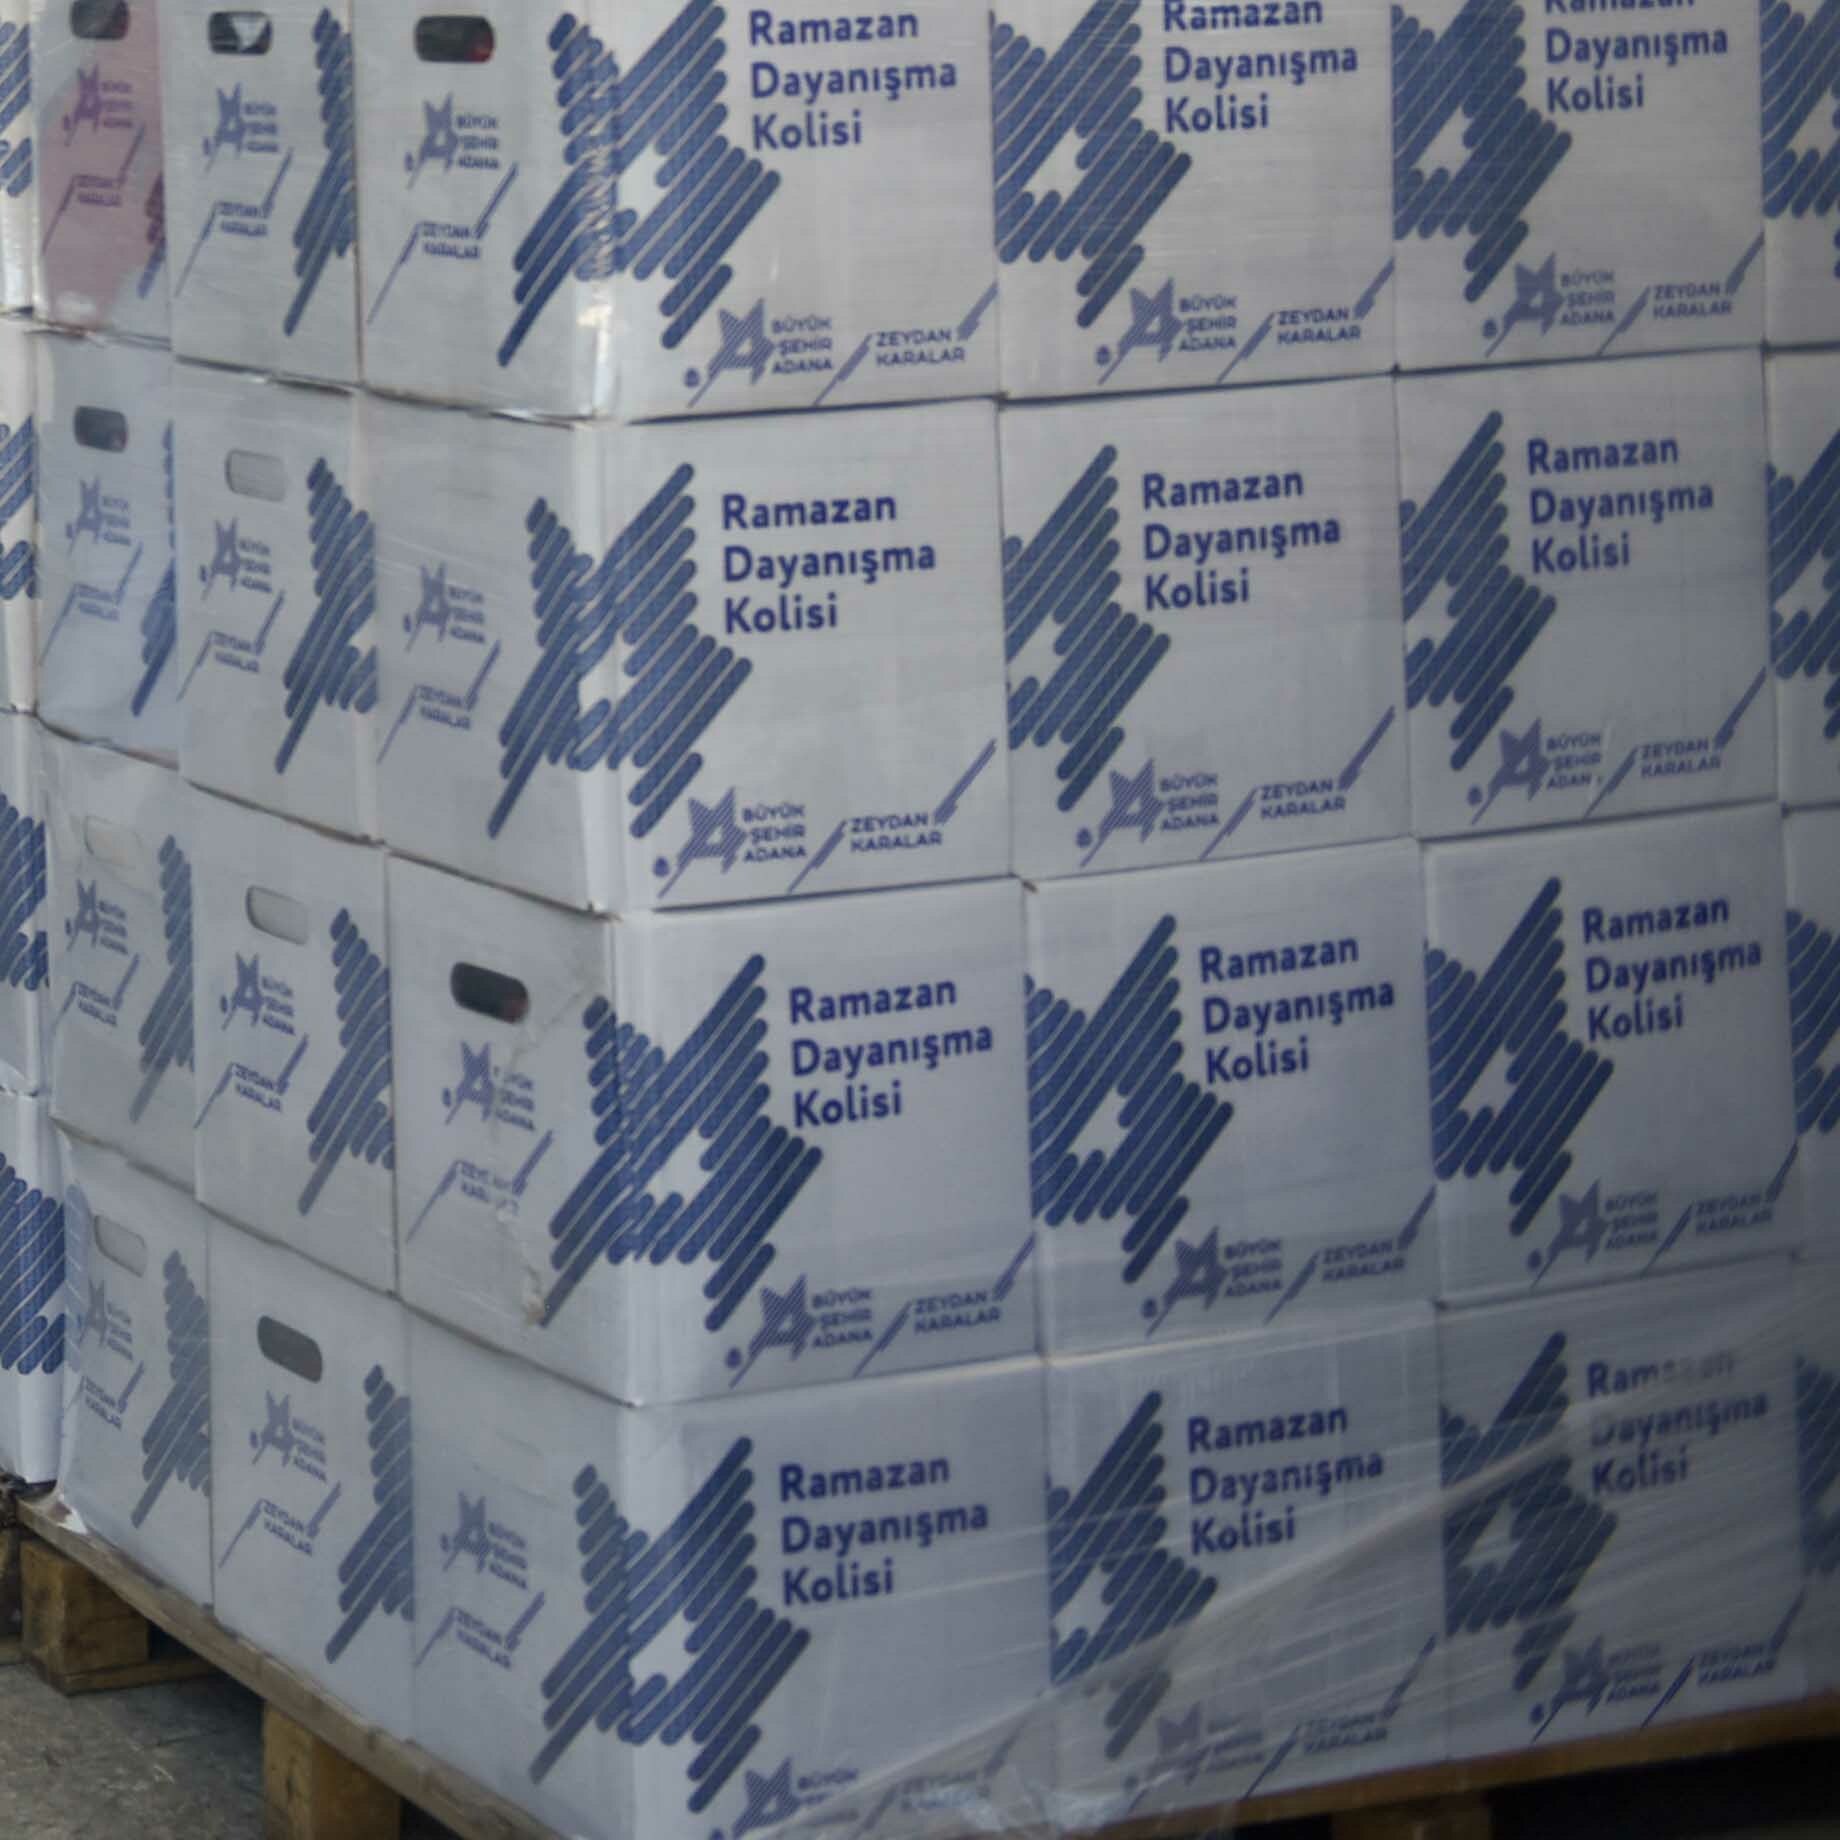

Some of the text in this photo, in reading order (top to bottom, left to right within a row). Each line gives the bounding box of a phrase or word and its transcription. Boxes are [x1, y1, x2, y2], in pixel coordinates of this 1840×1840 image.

[750, 10, 917, 46] Ramazan
[1546, 27, 1727, 69] Dayanışma
[751, 62, 956, 105] Dayanışma
[1165, 47, 1357, 89] Dayanışma
[1166, 93, 1268, 133] Kolisi
[1547, 74, 1643, 113] Kolisi
[752, 110, 861, 151] Kolisi
[1527, 438, 1678, 475] Ramazan
[723, 494, 896, 530] Ramazan
[1143, 472, 1303, 510] Ramazan
[1530, 485, 1713, 530] Dayanışma
[1144, 519, 1340, 565] Dayanışma
[1532, 531, 1629, 574] Kolisi
[724, 545, 935, 589] Dayanışma
[1145, 568, 1248, 611] Kolisi
[726, 592, 836, 634] Kolisi
[1583, 899, 1728, 944] Ramazan
[1200, 939, 1358, 983] Ramazan
[1585, 943, 1761, 996] Dayanışma
[790, 982, 955, 1024] Ramazan
[1203, 983, 1394, 1037] Dayanışma
[1588, 994, 1683, 1042] Kolisi
[792, 1027, 992, 1080] Dayanışma
[1206, 1036, 1308, 1085] Kolisi
[794, 1080, 901, 1128] Kolisi
[1188, 1406, 1348, 1454] Ramazan
[780, 1459, 949, 1502] Ramazan
[1188, 1452, 1384, 1508] Dayanışma
[1592, 1444, 1690, 1496] Kolisi
[782, 1505, 988, 1558] Dayanışma
[1191, 1510, 1294, 1555] Kolisi
[783, 1558, 893, 1606] Kolisi
